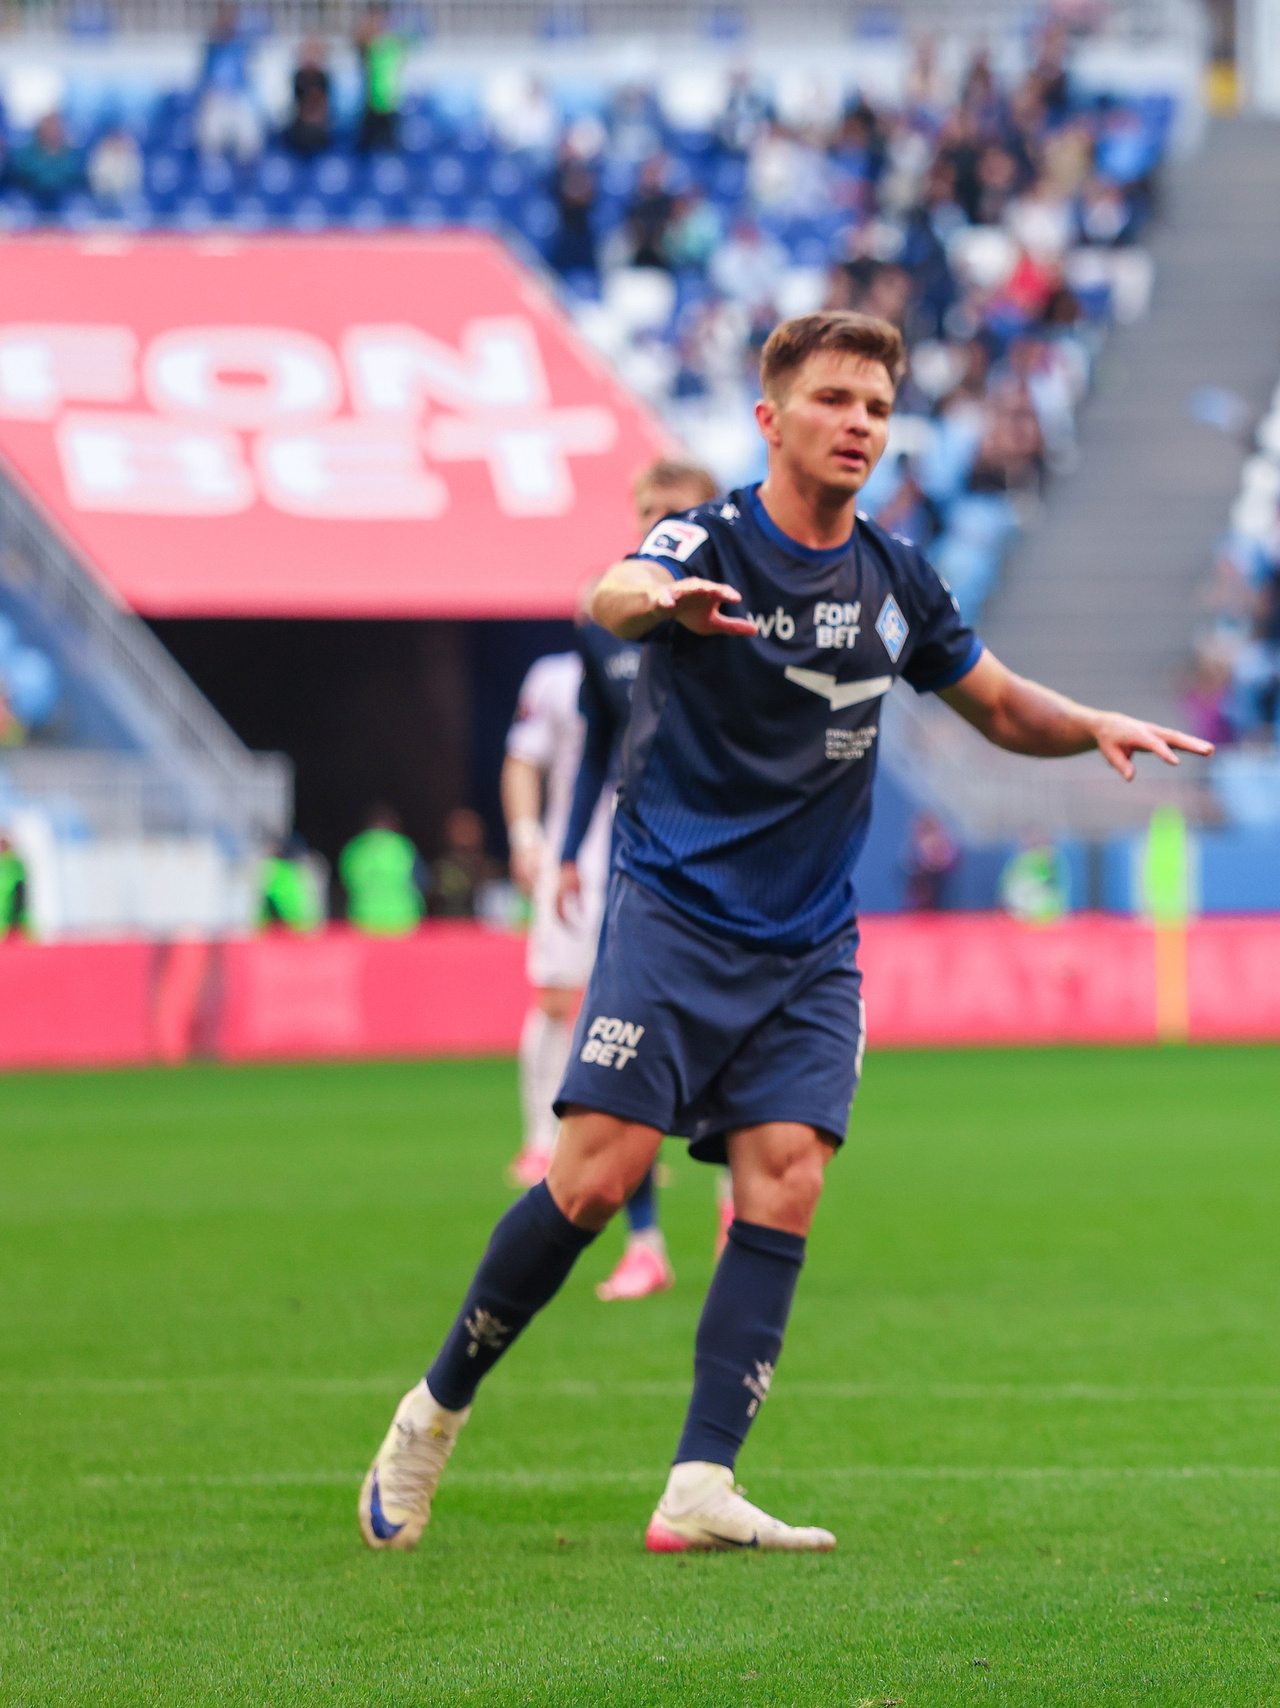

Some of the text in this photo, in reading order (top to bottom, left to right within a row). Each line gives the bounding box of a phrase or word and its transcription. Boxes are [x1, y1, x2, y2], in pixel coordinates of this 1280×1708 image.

[0, 316, 552, 428] FON
[55, 405, 618, 521] BET
[813, 600, 861, 626] FON
[816, 624, 861, 649] BET
[587, 1016, 645, 1048] FON
[580, 1039, 638, 1070] BET
